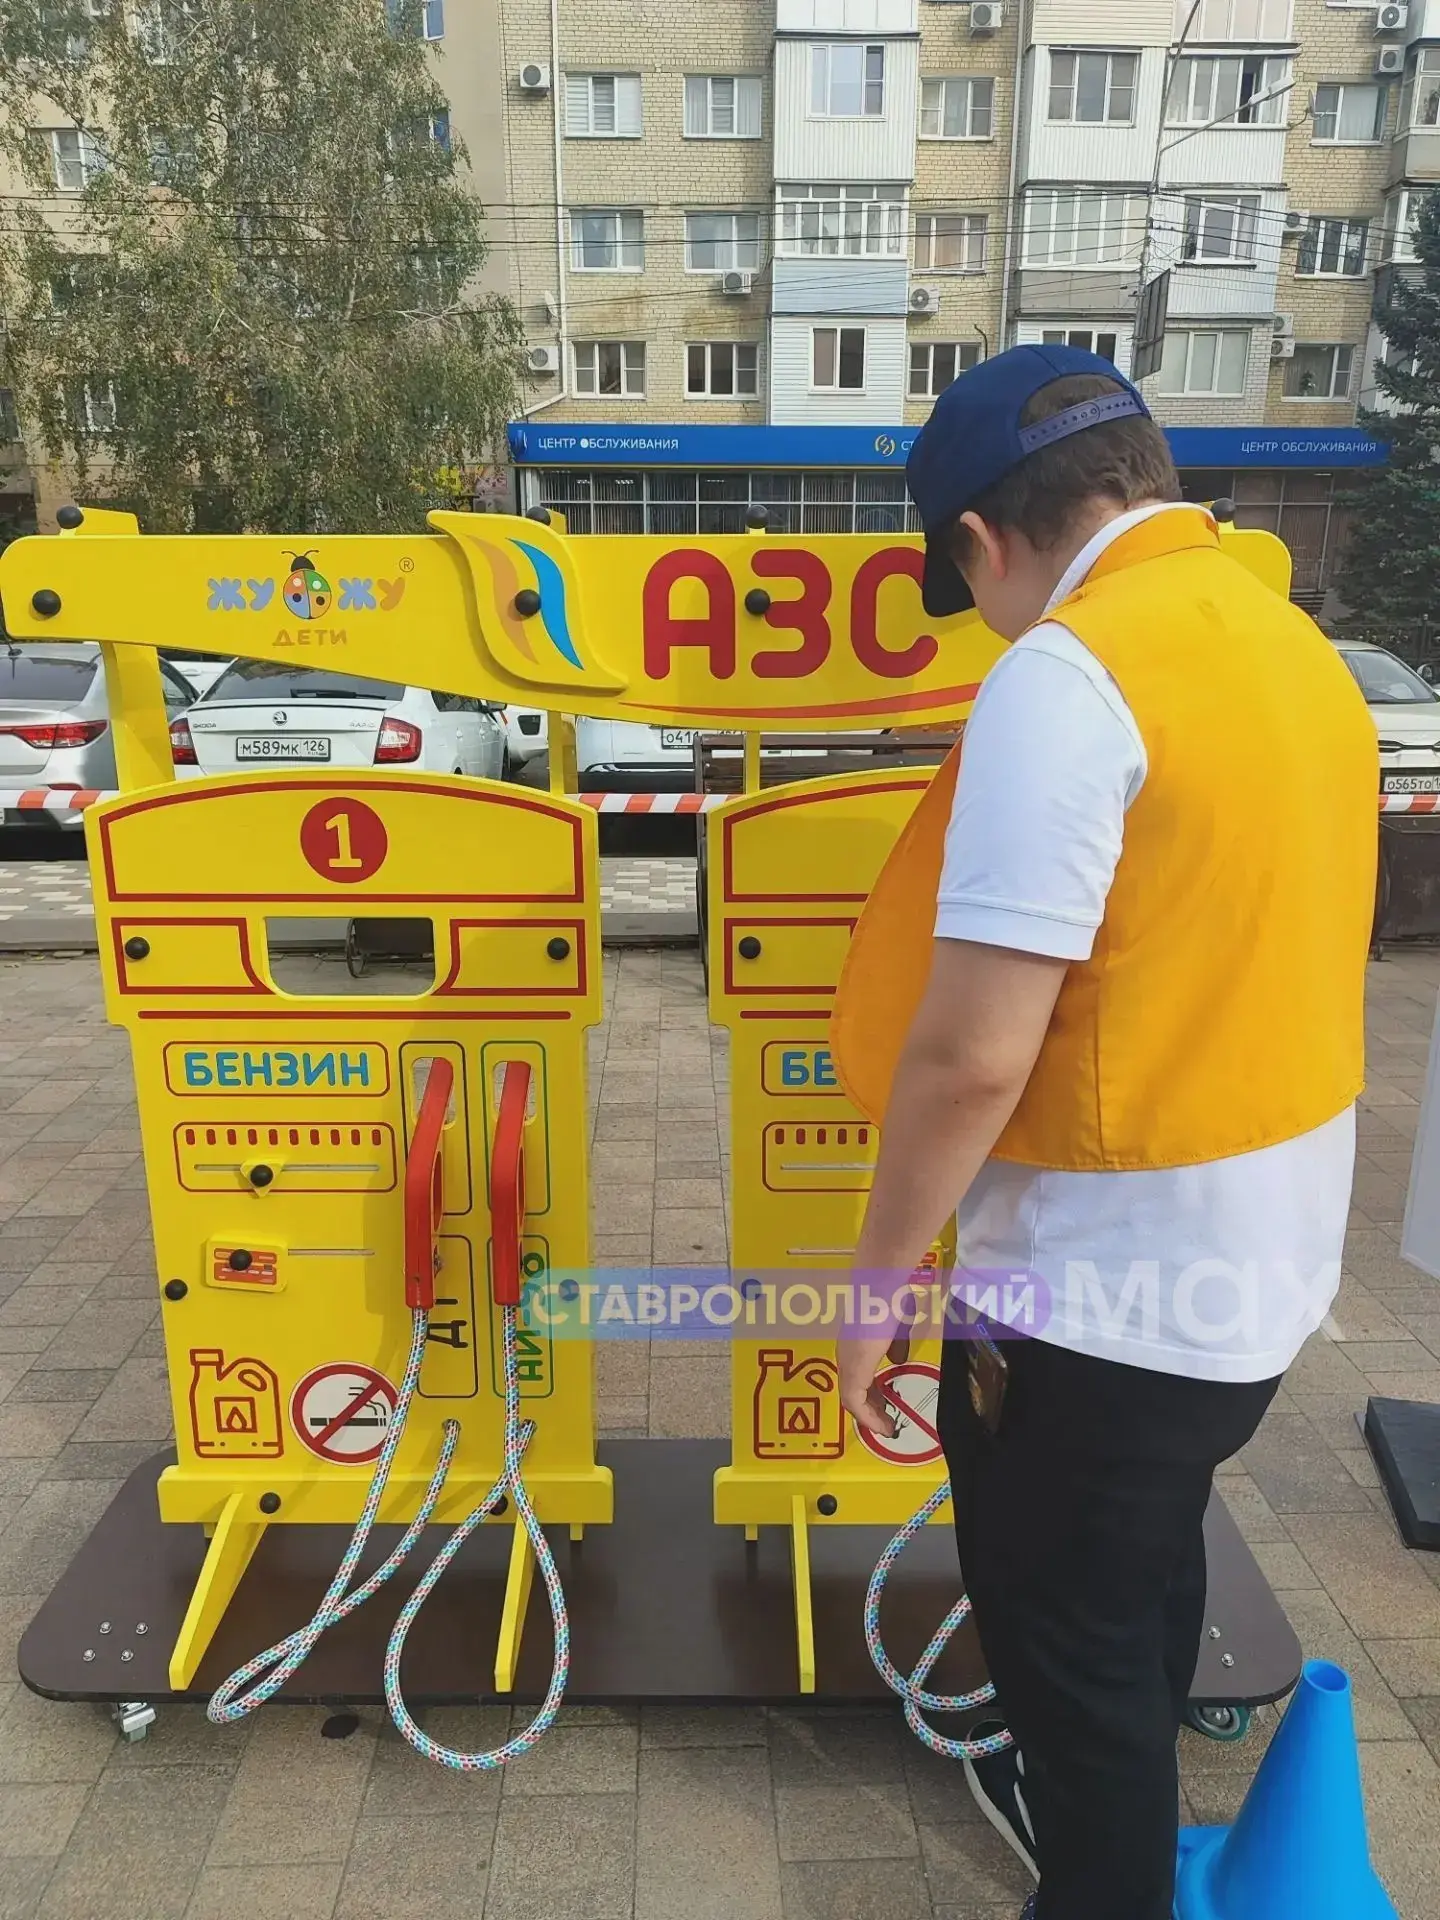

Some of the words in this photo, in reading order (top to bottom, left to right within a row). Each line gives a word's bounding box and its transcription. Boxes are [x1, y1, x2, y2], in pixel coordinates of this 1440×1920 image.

[538, 438, 576, 449] ЦЕНТР
[580, 438, 679, 449] ОБСЛУЖИВАНИЯ
[1241, 442, 1278, 453] ЦЕНТР
[1281, 442, 1376, 452] ОБСЛУЖИВАНИЯ
[643, 547, 938, 680] АЗС
[272, 629, 347, 646] ДЕТИ
[241, 741, 299, 755] М589МК
[303, 740, 325, 751] 126
[325, 814, 363, 868] 1
[184, 1052, 370, 1087] БЕНЗИН
[782, 1051, 838, 1086] БЕ
